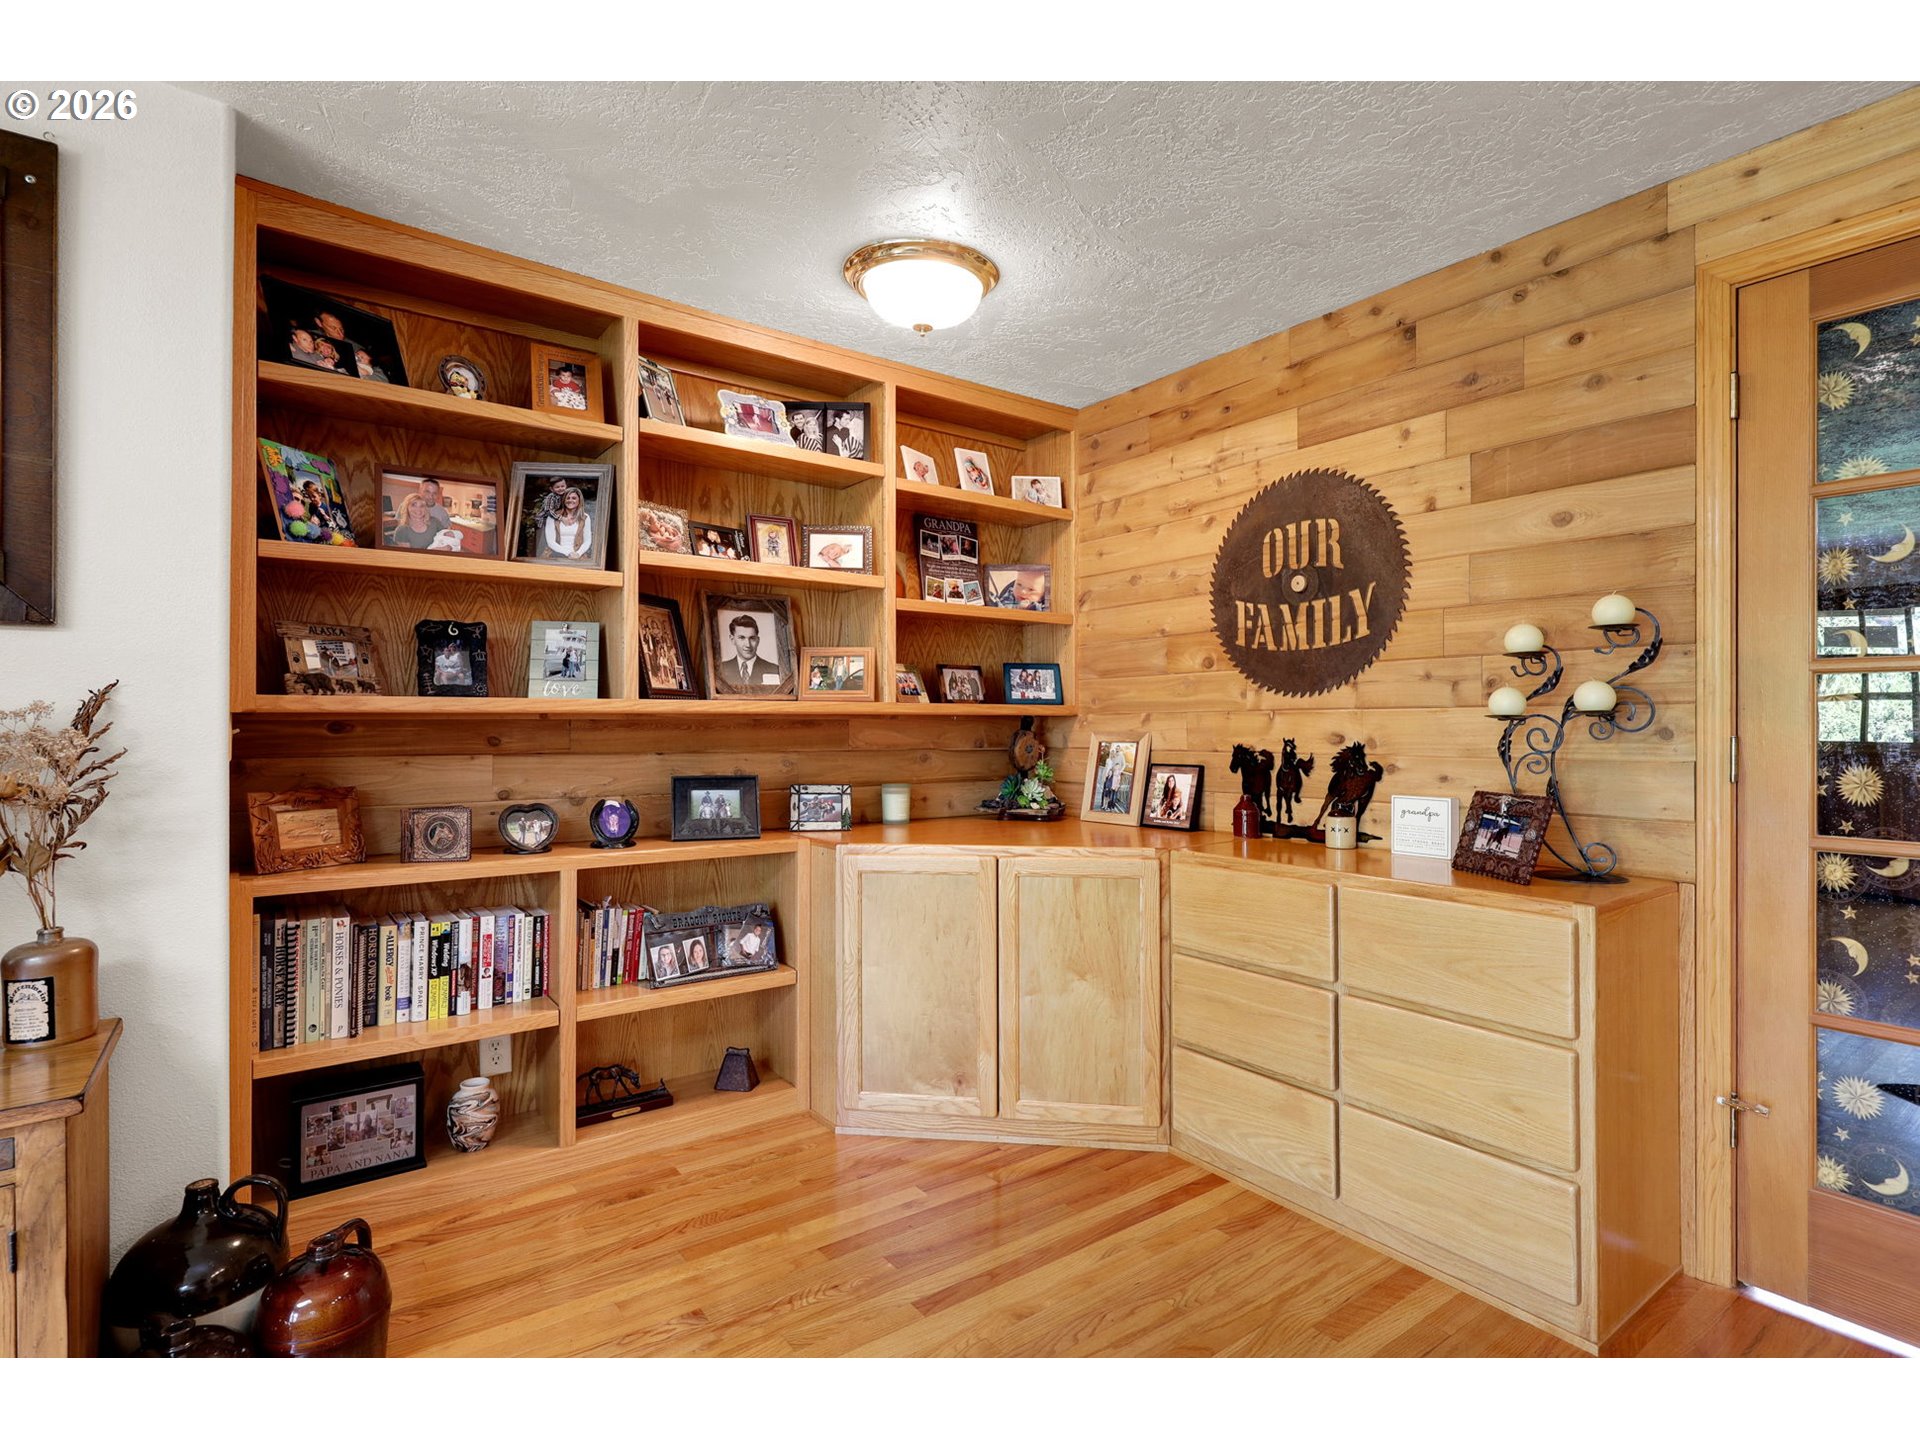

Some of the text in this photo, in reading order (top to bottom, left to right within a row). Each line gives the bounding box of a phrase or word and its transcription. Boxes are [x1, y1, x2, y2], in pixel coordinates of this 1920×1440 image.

[924, 517, 972, 534] GRANDPA
[1262, 518, 1344, 578] OUR
[308, 624, 346, 637] ALASKA
[1235, 581, 1377, 651] FAMILY
[543, 681, 581, 697] love
[1400, 806, 1440, 823] grandpa
[713, 911, 741, 923] RIGHTS
[335, 932, 344, 965] HORSES
[367, 928, 377, 1000] HORSE OWNER'S
[386, 934, 394, 966] ALLERGY
[274, 946, 286, 1008] HORSE CARE
[431, 968, 437, 976] XP
[335, 977, 343, 1009] PONIES
[310, 1165, 341, 1180] PAPA
[344, 1157, 372, 1172] AND
[375, 1149, 410, 1163] NANA
